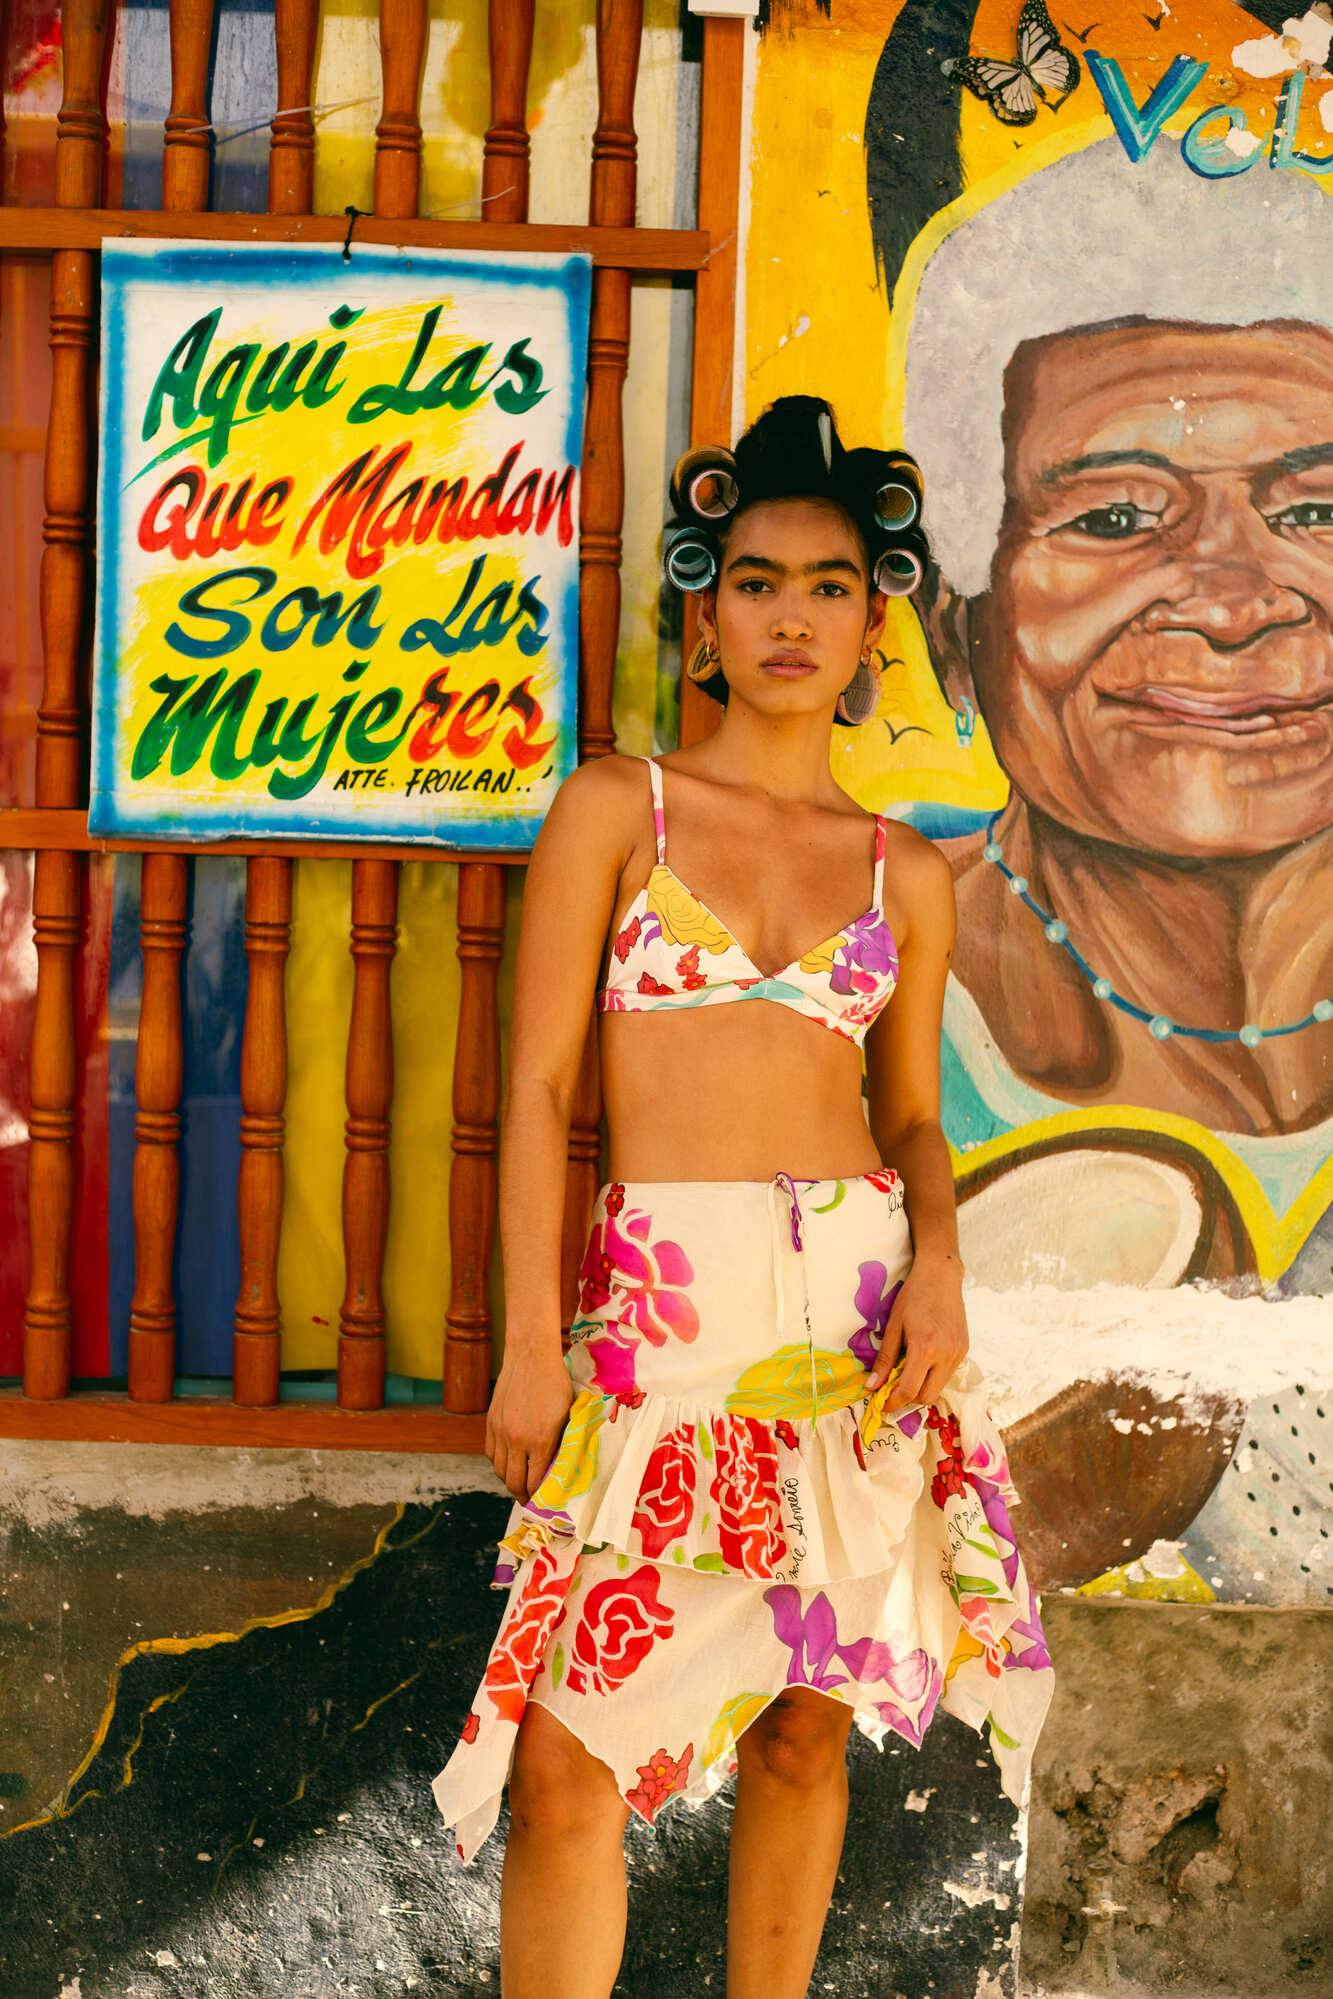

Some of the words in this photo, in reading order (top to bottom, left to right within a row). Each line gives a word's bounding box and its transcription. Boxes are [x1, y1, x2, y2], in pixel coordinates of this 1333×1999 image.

[140, 304, 366, 468] Aqui
[347, 304, 555, 424] Las
[138, 465, 295, 561] Que
[291, 440, 576, 580] Mandan
[164, 566, 391, 659] Son
[399, 553, 551, 657] Las
[131, 660, 558, 800] Mujeres
